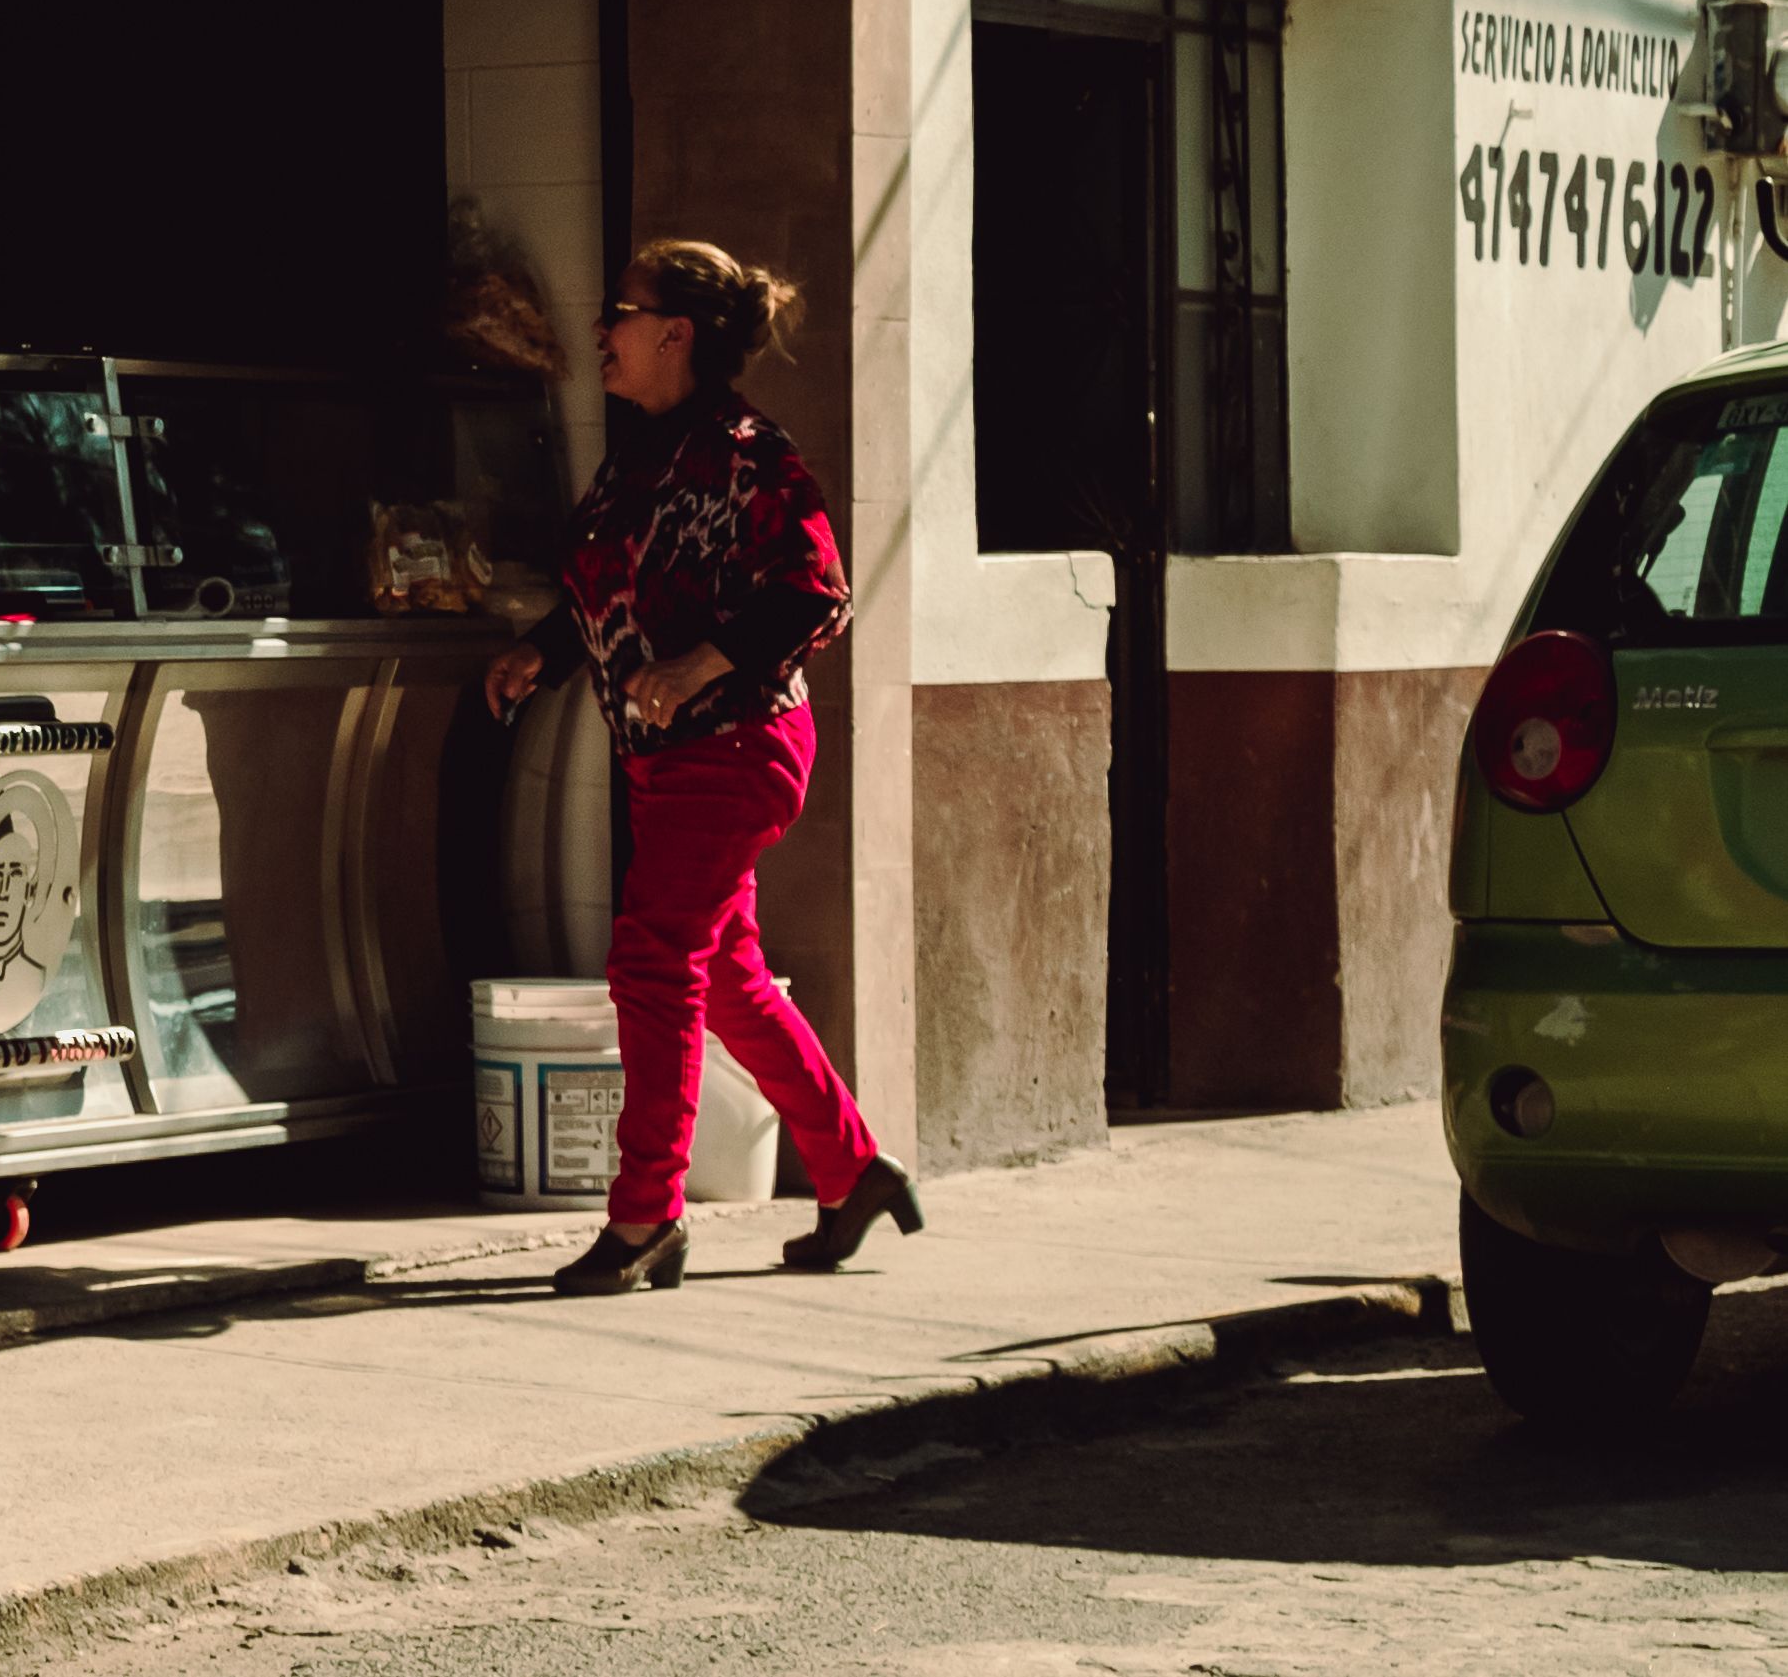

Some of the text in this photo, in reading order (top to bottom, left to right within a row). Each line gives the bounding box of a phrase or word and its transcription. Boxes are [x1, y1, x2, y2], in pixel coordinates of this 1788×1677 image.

[1460, 10, 1679, 101] SERVICIO A DOMICILIO
